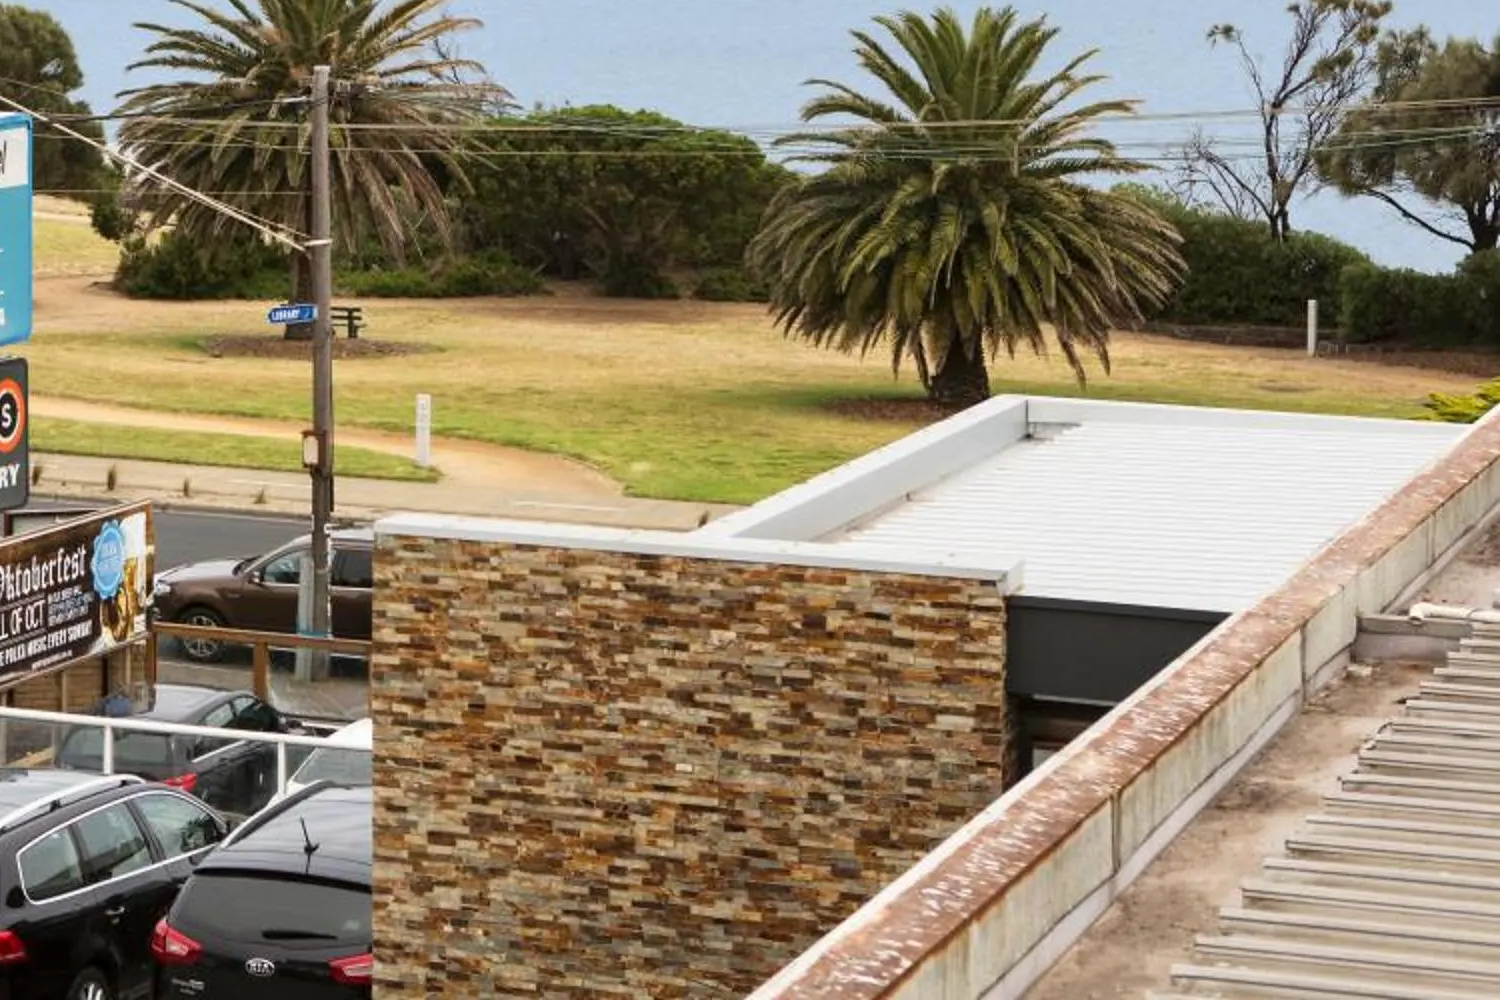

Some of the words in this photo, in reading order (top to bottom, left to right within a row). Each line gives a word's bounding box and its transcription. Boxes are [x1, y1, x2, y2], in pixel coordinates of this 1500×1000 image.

[10, 606, 23, 636] OF
[25, 600, 46, 631] OCT
[47, 628, 67, 650] EVERY
